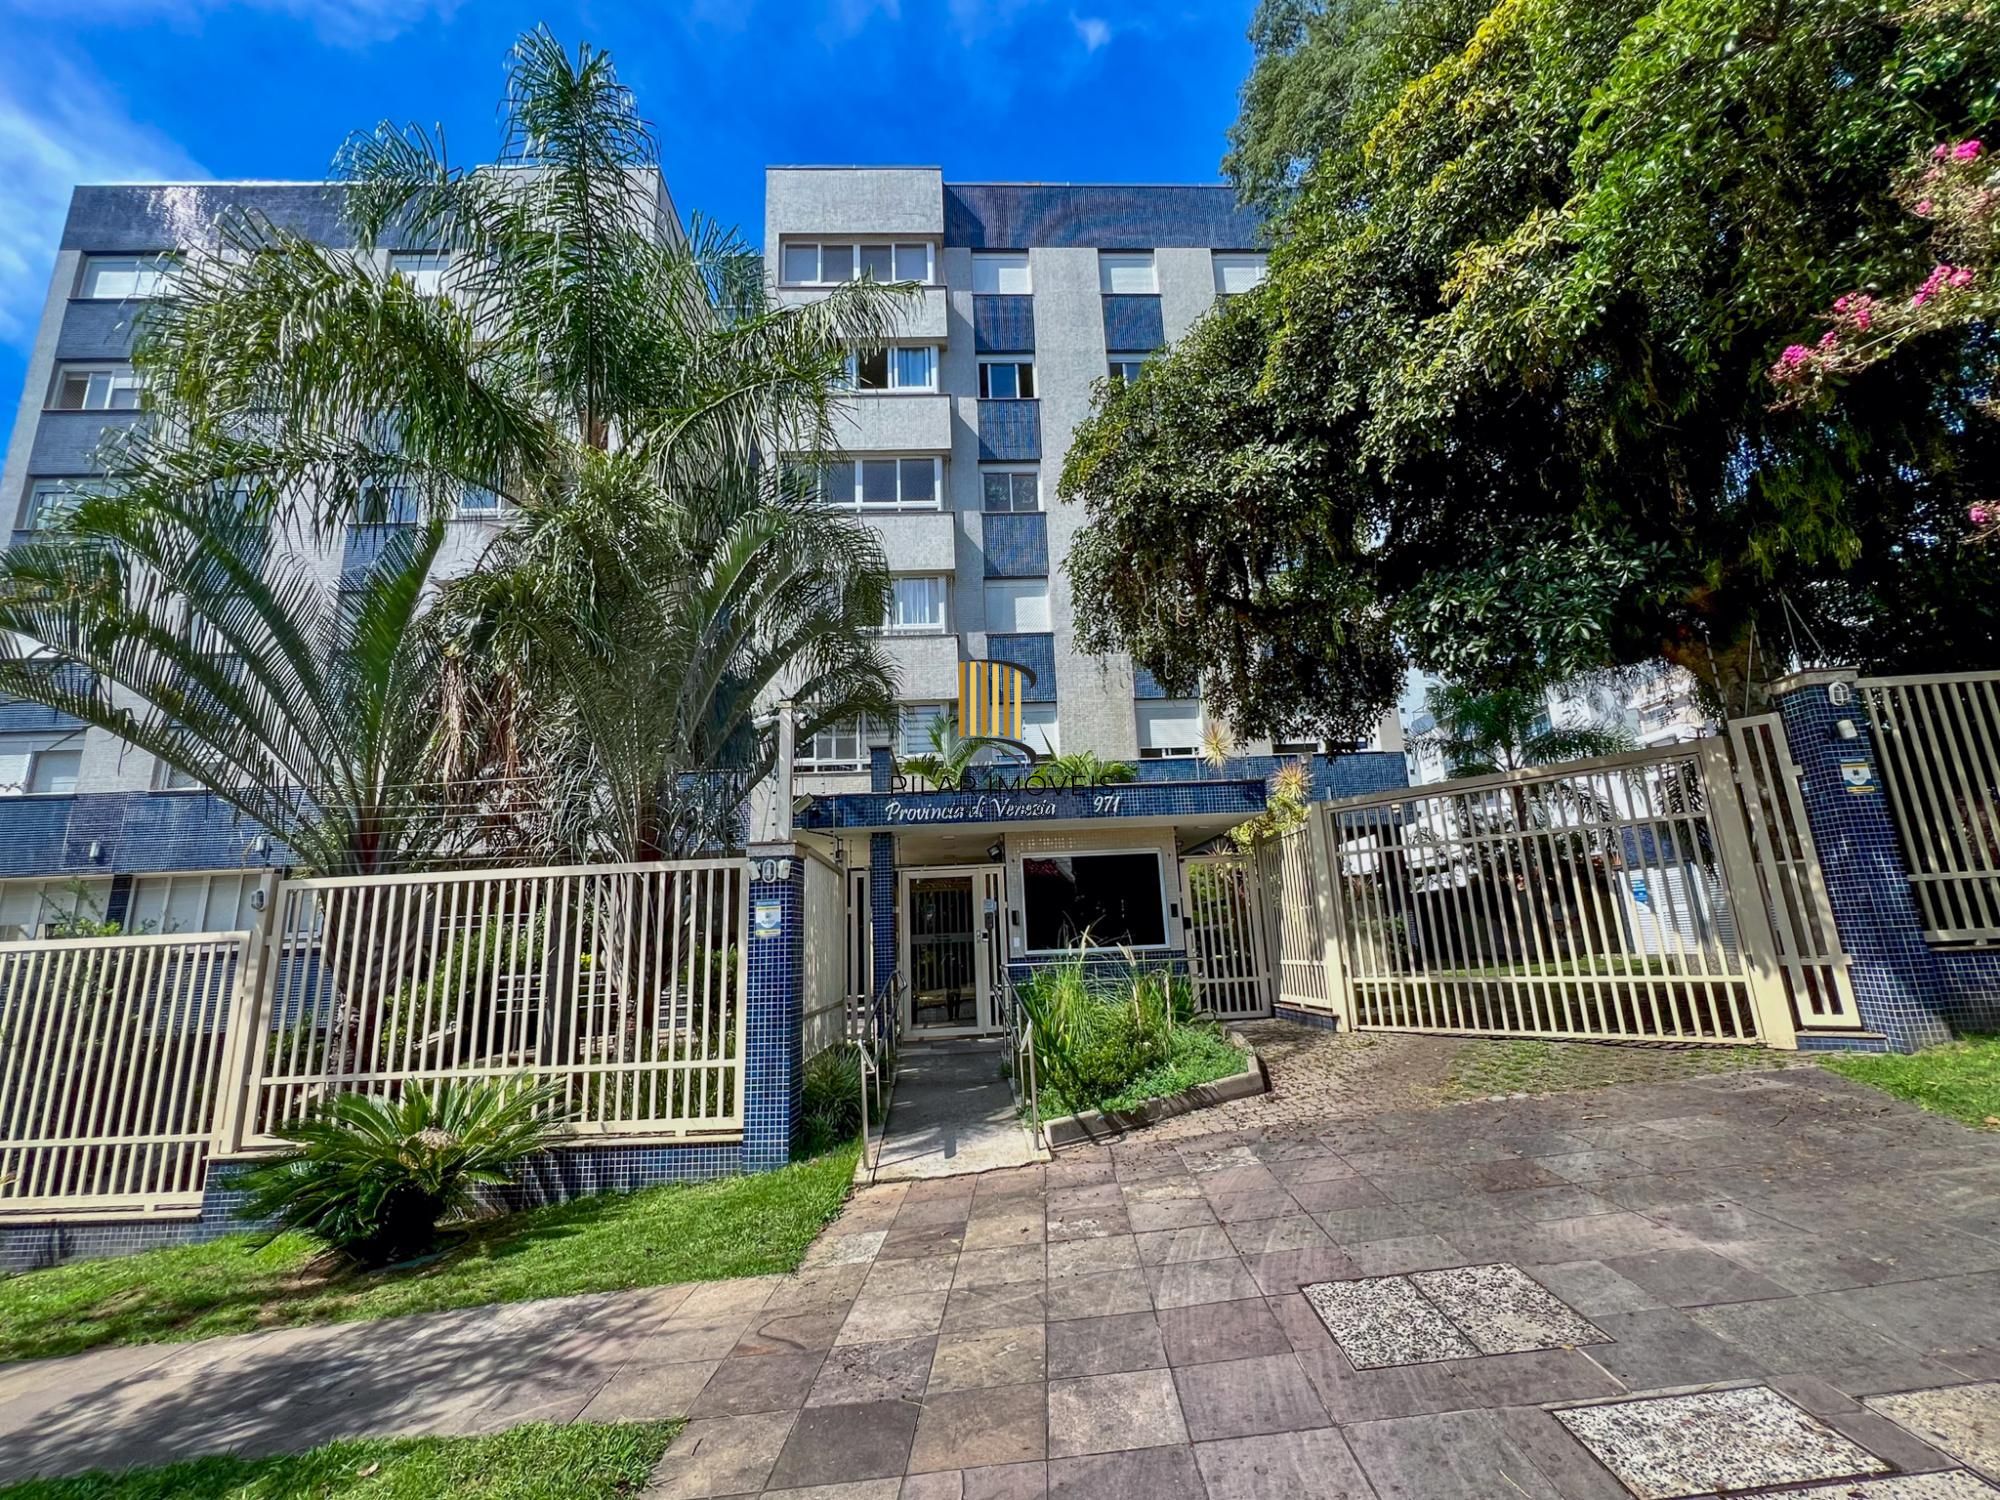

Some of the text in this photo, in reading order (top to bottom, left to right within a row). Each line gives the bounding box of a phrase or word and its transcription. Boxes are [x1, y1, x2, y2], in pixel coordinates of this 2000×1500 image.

[885, 801, 964, 821] Provincia
[991, 798, 1056, 817] Venezia
[1094, 796, 1120, 813] 971
